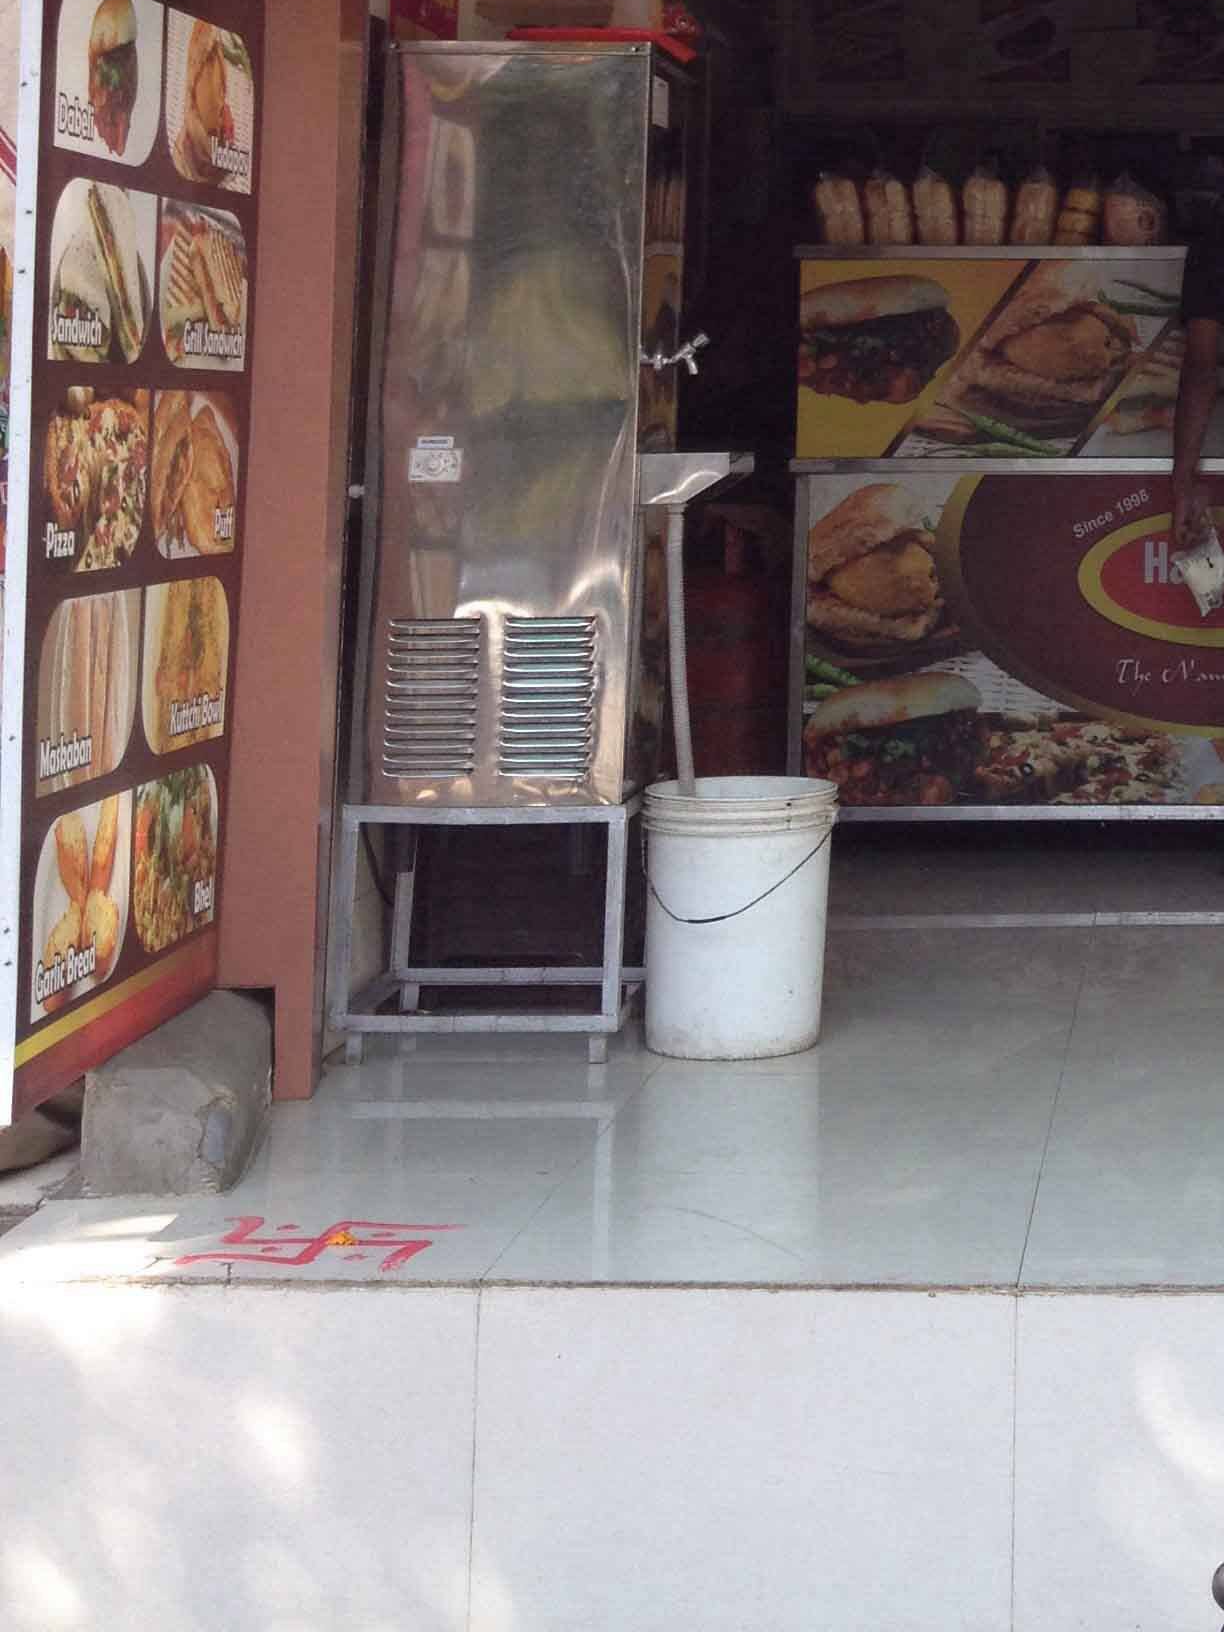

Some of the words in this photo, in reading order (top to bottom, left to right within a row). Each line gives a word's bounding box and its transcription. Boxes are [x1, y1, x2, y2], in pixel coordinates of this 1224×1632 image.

[50, 306, 102, 346] Sandwich
[45, 521, 76, 560] Pizza
[1072, 511, 1113, 539] Since
[1116, 658, 1152, 697] The
[193, 877, 216, 915] Bhel
[35, 959, 66, 1005] Garlic
[66, 931, 97, 987] Bread
